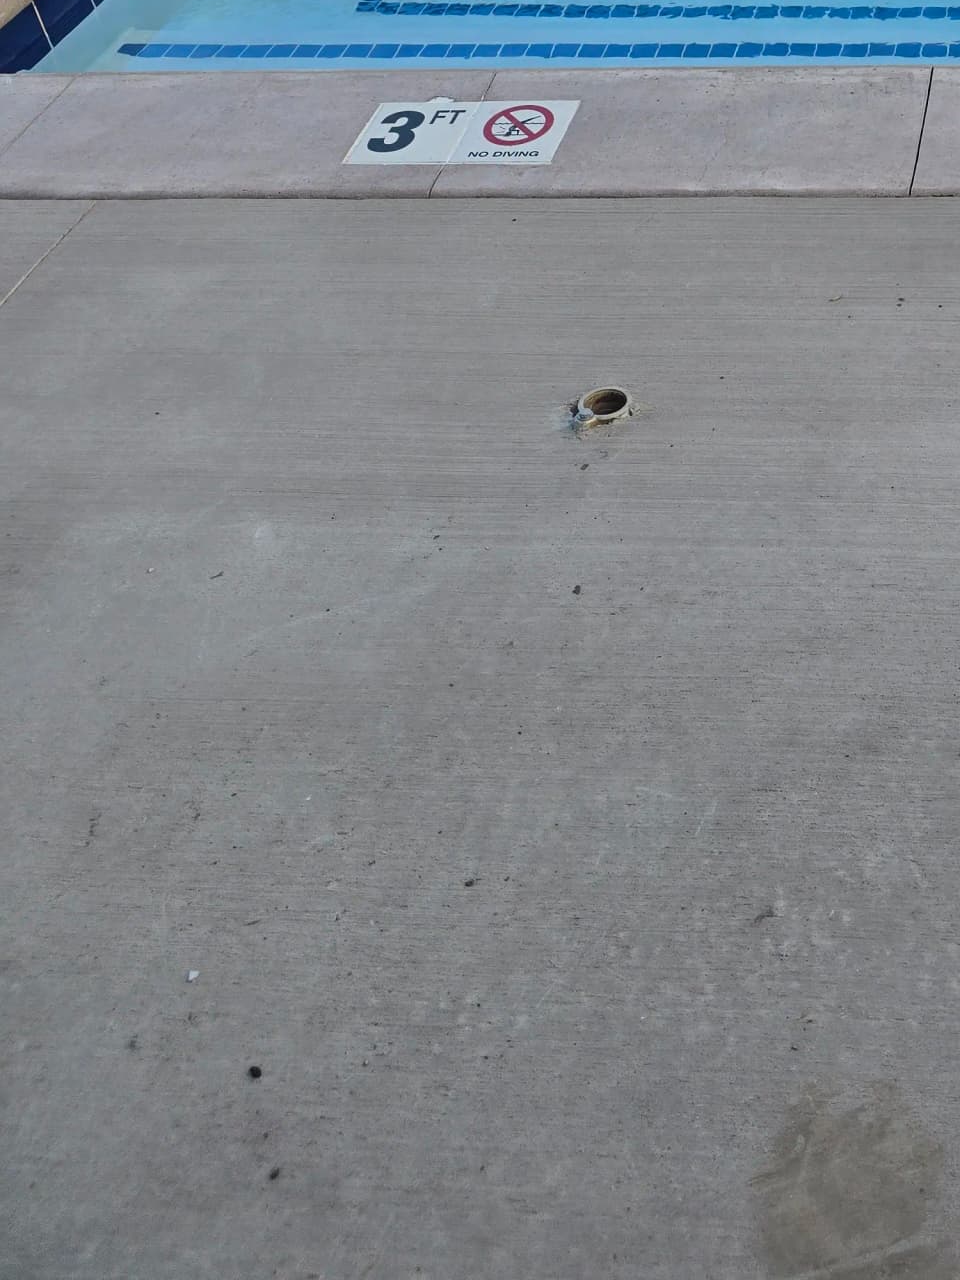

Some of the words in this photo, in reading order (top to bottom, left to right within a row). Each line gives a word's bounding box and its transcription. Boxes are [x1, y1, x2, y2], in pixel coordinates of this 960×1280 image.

[367, 110, 426, 153] 3
[429, 109, 466, 125] FT
[492, 150, 540, 158] DIVING
